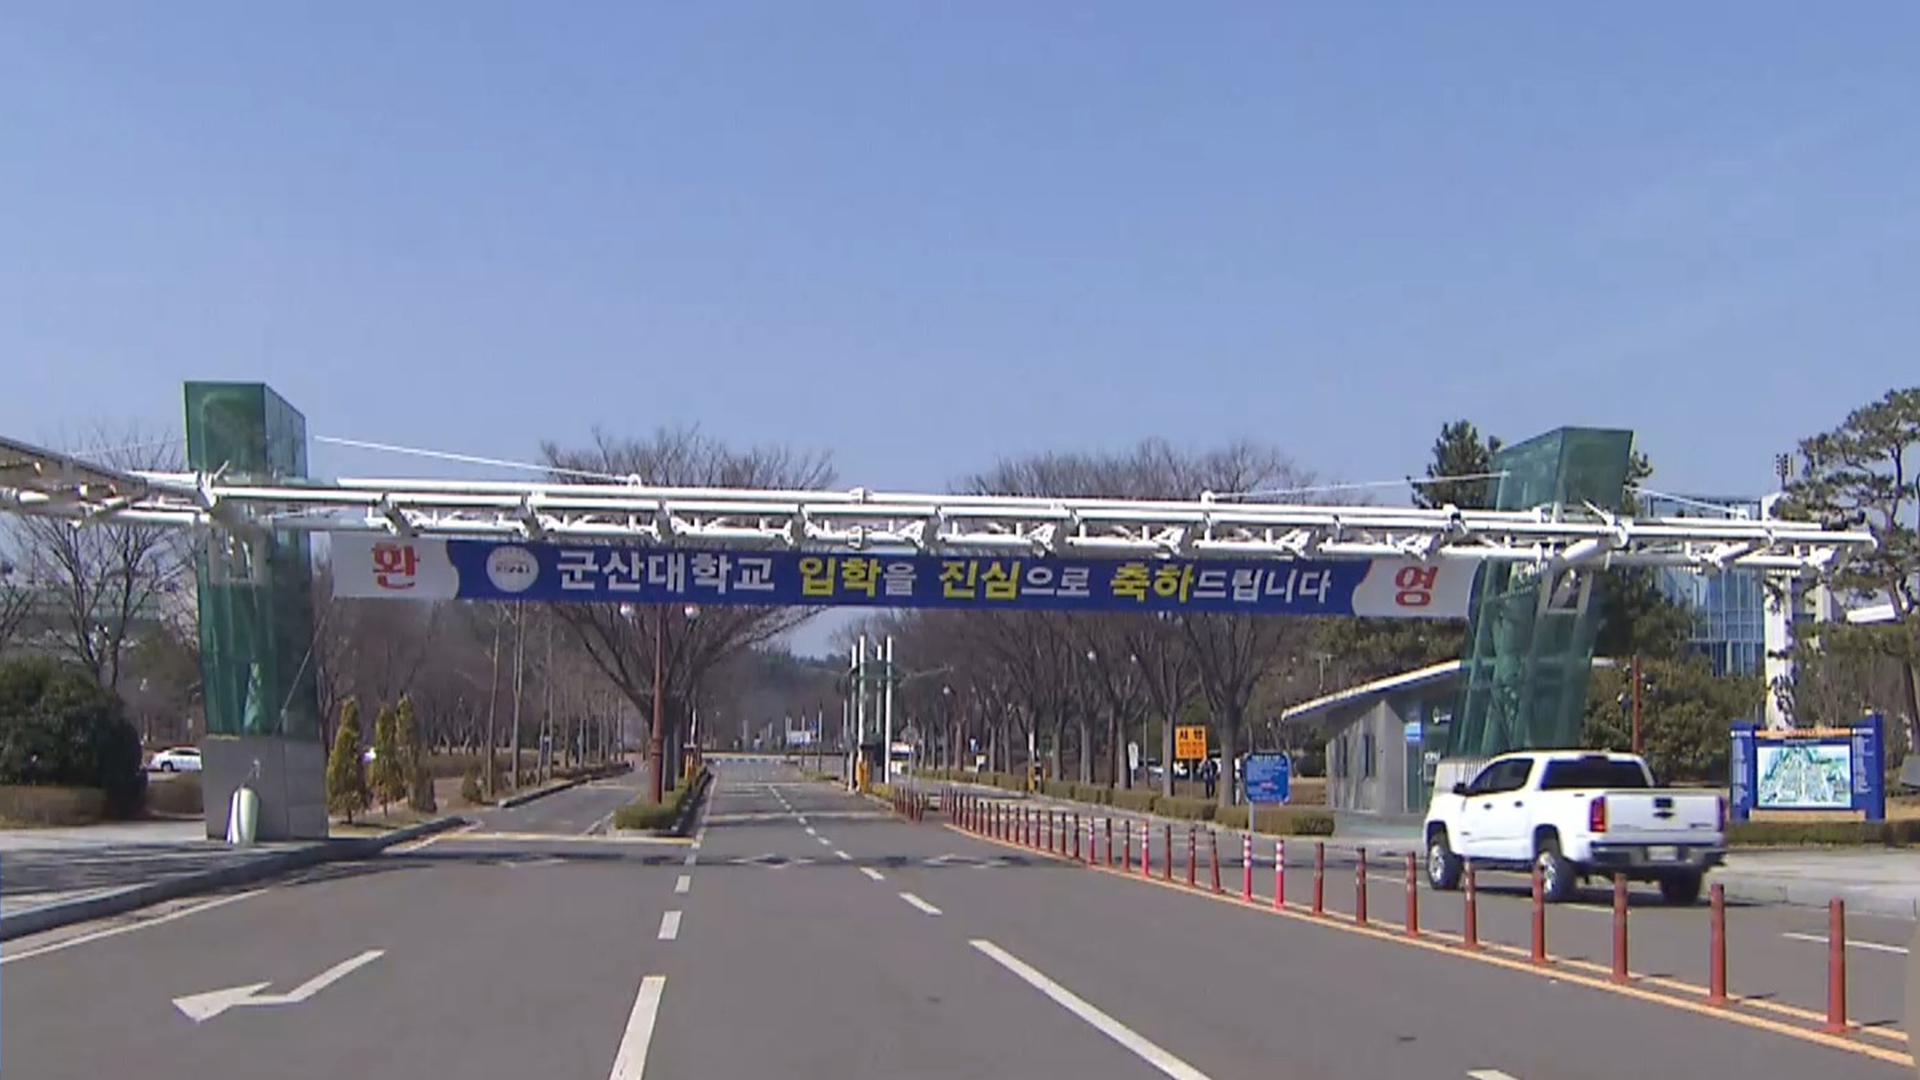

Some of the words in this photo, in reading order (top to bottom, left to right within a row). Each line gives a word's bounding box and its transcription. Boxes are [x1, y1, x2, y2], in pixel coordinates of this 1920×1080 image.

[371, 542, 419, 590] 환
[557, 551, 775, 594] 군산대학교
[799, 556, 917, 597] 입학을
[939, 560, 1090, 599] 진심으로
[1111, 562, 1331, 602] 축하드립니다
[1395, 566, 1437, 607] 영
